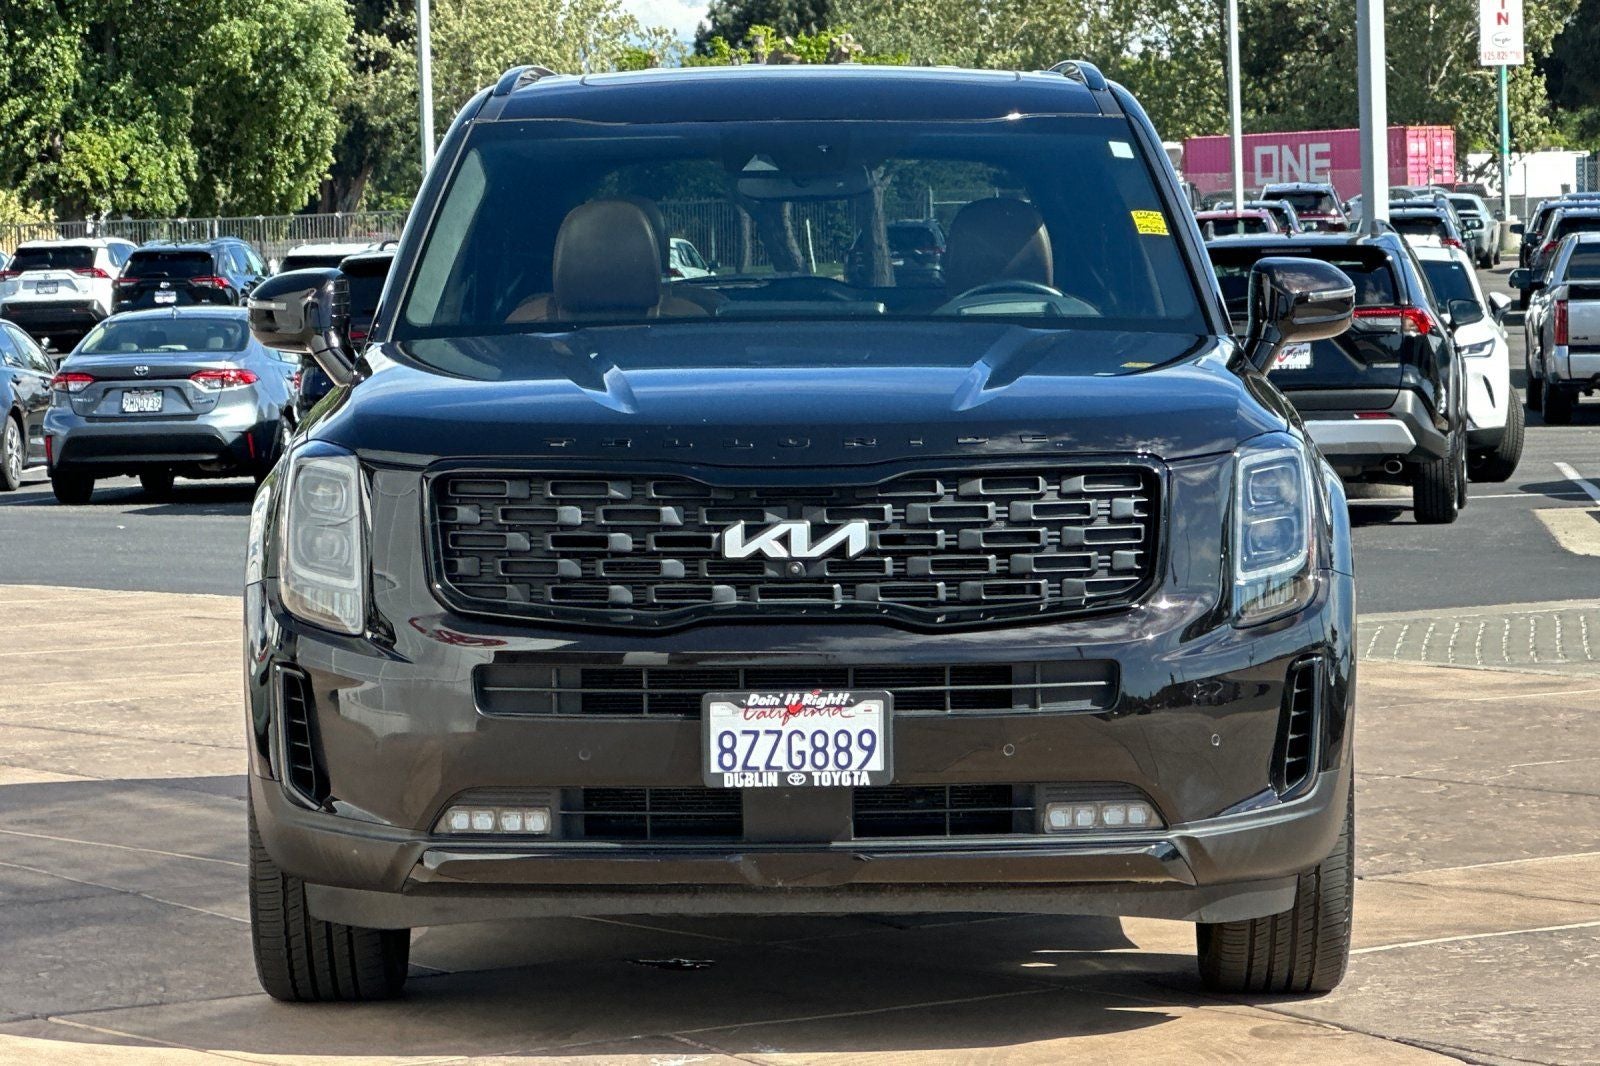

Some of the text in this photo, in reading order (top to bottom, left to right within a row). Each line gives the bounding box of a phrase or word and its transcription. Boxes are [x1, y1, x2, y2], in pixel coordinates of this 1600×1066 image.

[1254, 143, 1331, 186] ONE
[724, 521, 867, 558] KIA
[802, 693, 849, 708] Right!
[717, 729, 877, 771] 8ZZG889
[723, 771, 871, 787] DUBLIN TOYOTA
